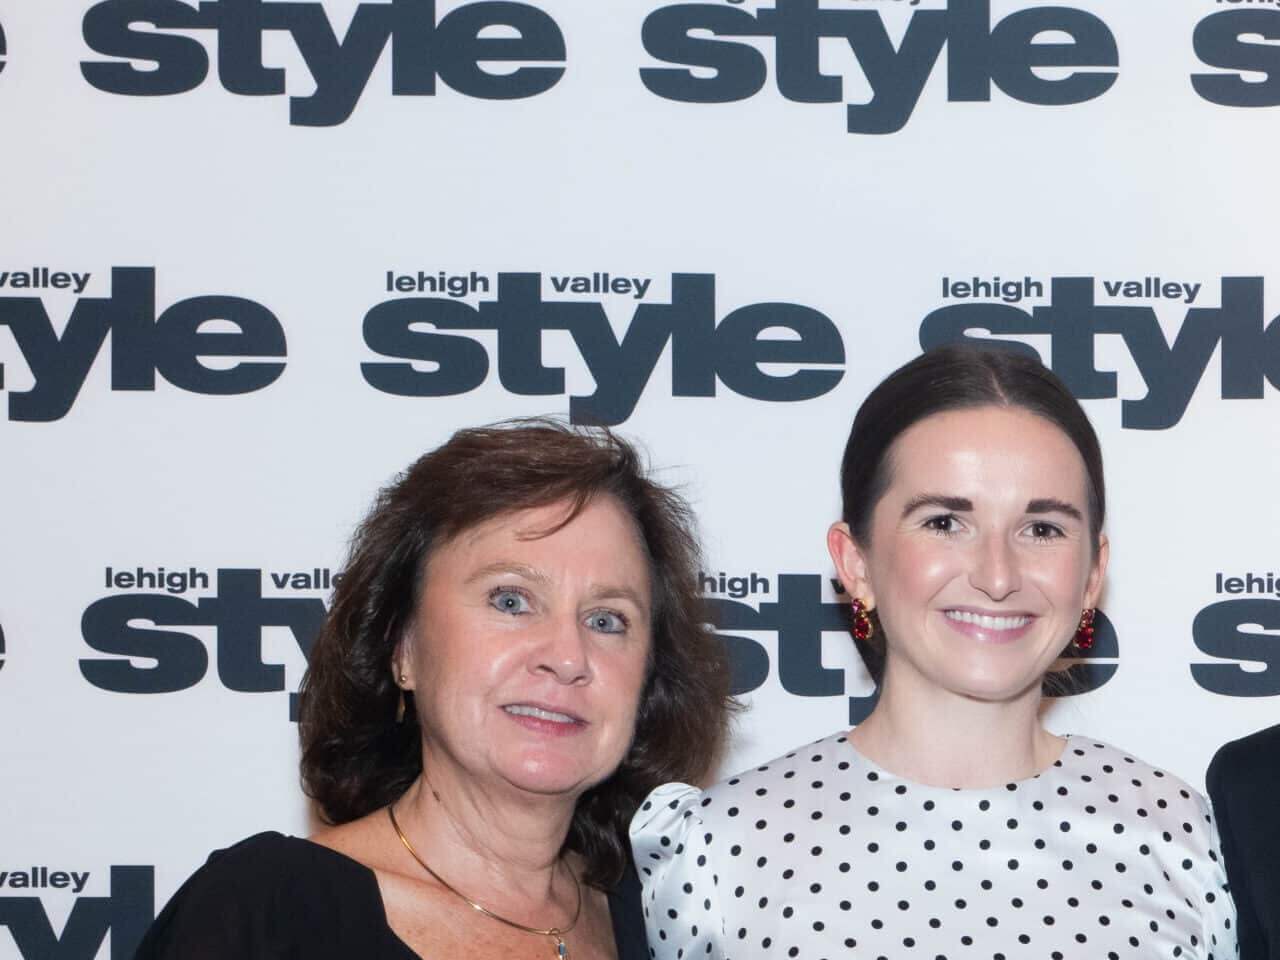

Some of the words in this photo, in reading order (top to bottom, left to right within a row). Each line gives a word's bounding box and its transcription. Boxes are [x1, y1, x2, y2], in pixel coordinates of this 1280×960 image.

[79, 0, 567, 127] style
[639, 0, 1119, 135] style
[386, 271, 490, 297] lehigh
[551, 272, 651, 299] valley
[942, 276, 1044, 303] lehigh
[1103, 277, 1202, 304] valley
[0, 266, 288, 423] yle
[360, 271, 846, 427] style
[105, 567, 209, 594] lehigh
[271, 568, 346, 590] valle
[698, 572, 770, 599] high
